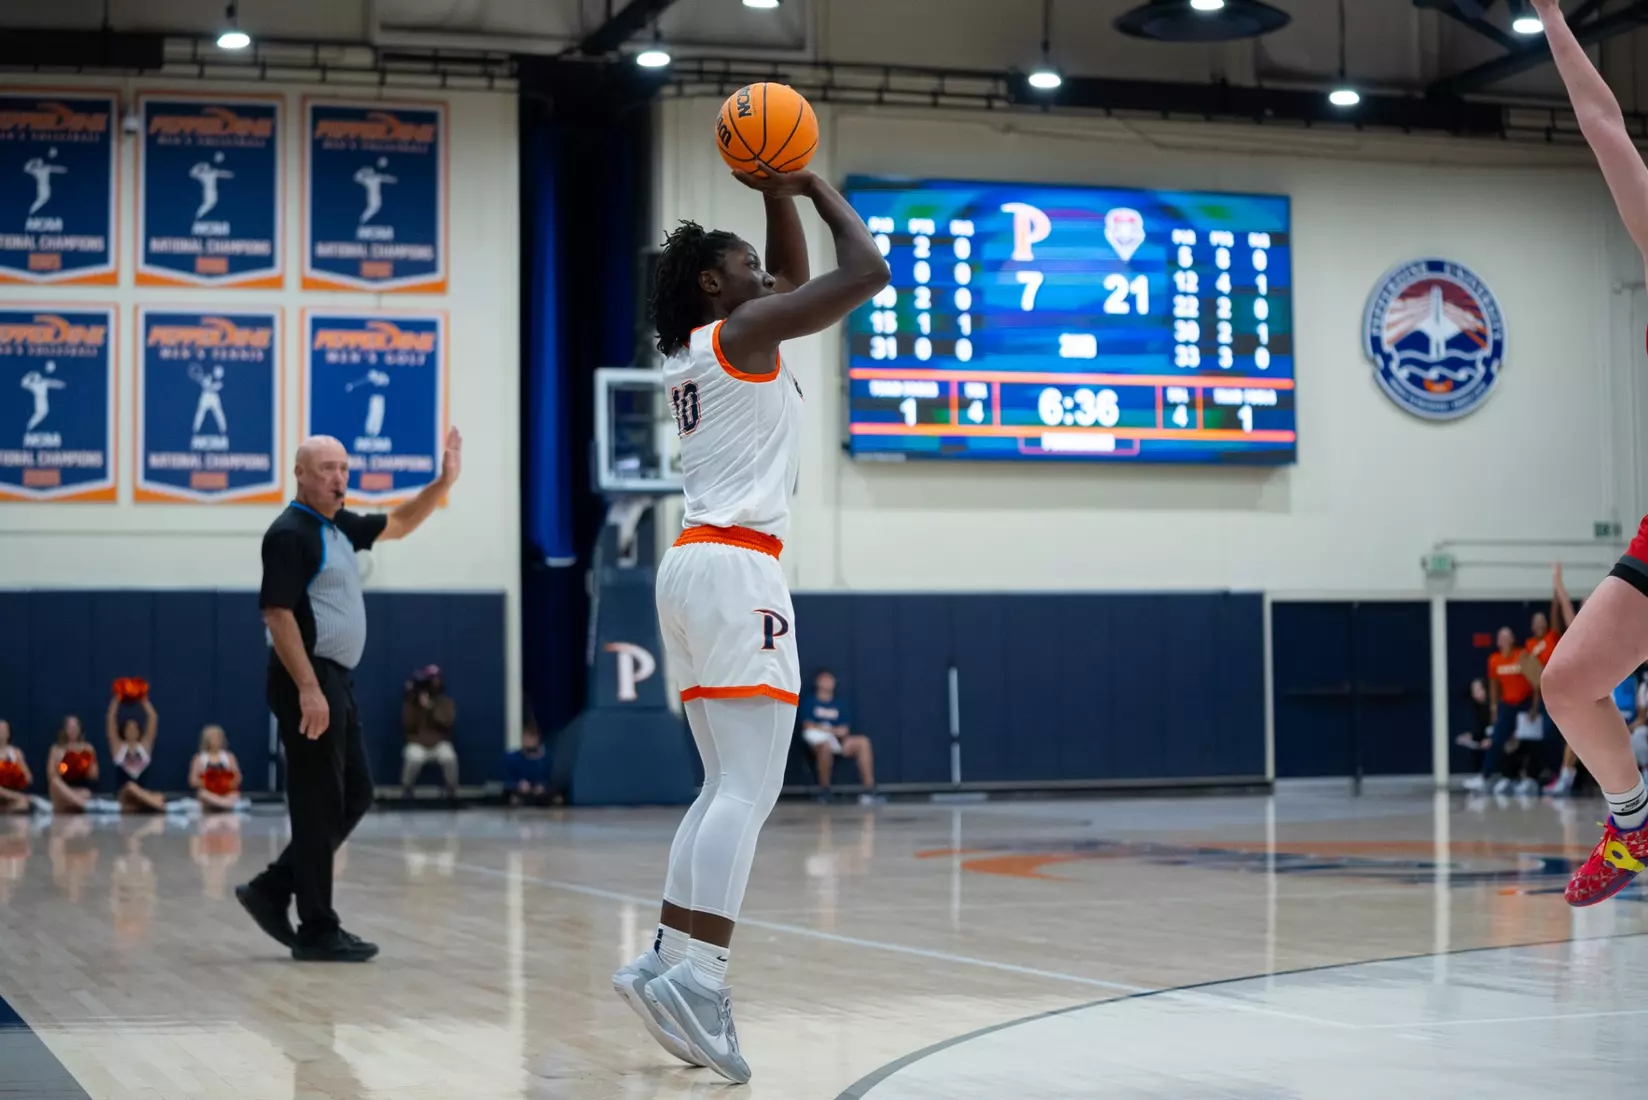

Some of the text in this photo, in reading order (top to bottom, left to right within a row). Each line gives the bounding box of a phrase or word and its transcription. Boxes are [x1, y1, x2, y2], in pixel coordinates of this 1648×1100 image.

[1001, 202, 1051, 261] P
[1016, 270, 1044, 312] 7
[1103, 273, 1149, 315] 21
[1255, 273, 1268, 296] 1
[917, 312, 931, 335] 1
[957, 313, 971, 336] 1
[1257, 322, 1269, 345] 1
[900, 398, 917, 427] 1
[967, 400, 985, 424] 4
[1038, 387, 1120, 427] 6:36
[1172, 404, 1189, 427] 4
[1237, 404, 1253, 434] 1
[753, 608, 789, 650] P
[604, 642, 656, 701] P
